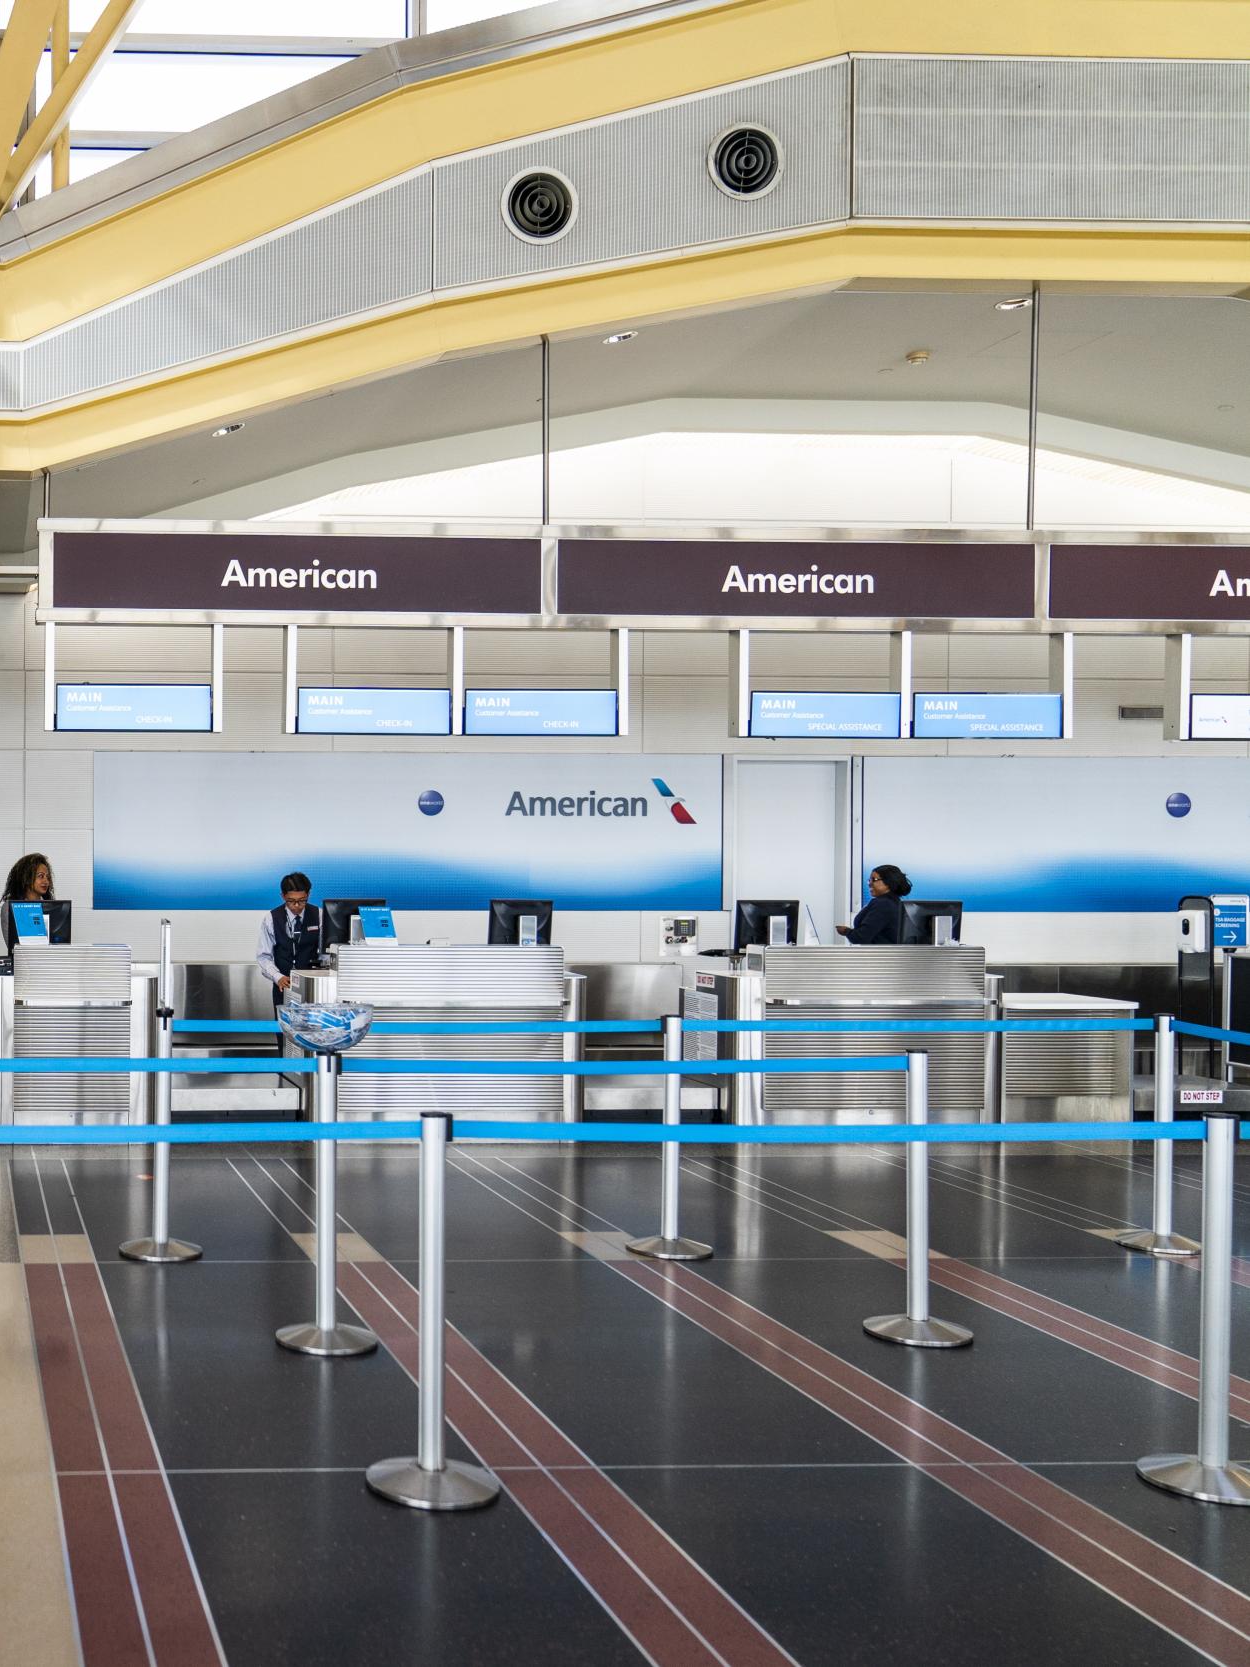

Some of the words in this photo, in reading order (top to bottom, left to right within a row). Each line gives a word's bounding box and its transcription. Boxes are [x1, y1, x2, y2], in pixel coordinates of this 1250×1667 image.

[220, 559, 377, 590] American
[721, 564, 874, 594] American
[66, 692, 102, 702] MAIN
[307, 695, 344, 705] MAIN
[474, 697, 511, 707] MAIN
[760, 699, 796, 709] MAIN
[923, 701, 958, 711] MAIN
[542, 720, 579, 728] CHECK-IN
[807, 723, 838, 731] SPECIAL
[838, 723, 883, 731] ASSISTANCE
[969, 723, 1000, 732] SPECIAL
[1000, 723, 1044, 732] ASSISTANCE
[505, 790, 648, 817] American
[1183, 1092, 1191, 1101] DO
[1193, 1092, 1205, 1101] NOT
[1206, 1092, 1220, 1101] STEP
